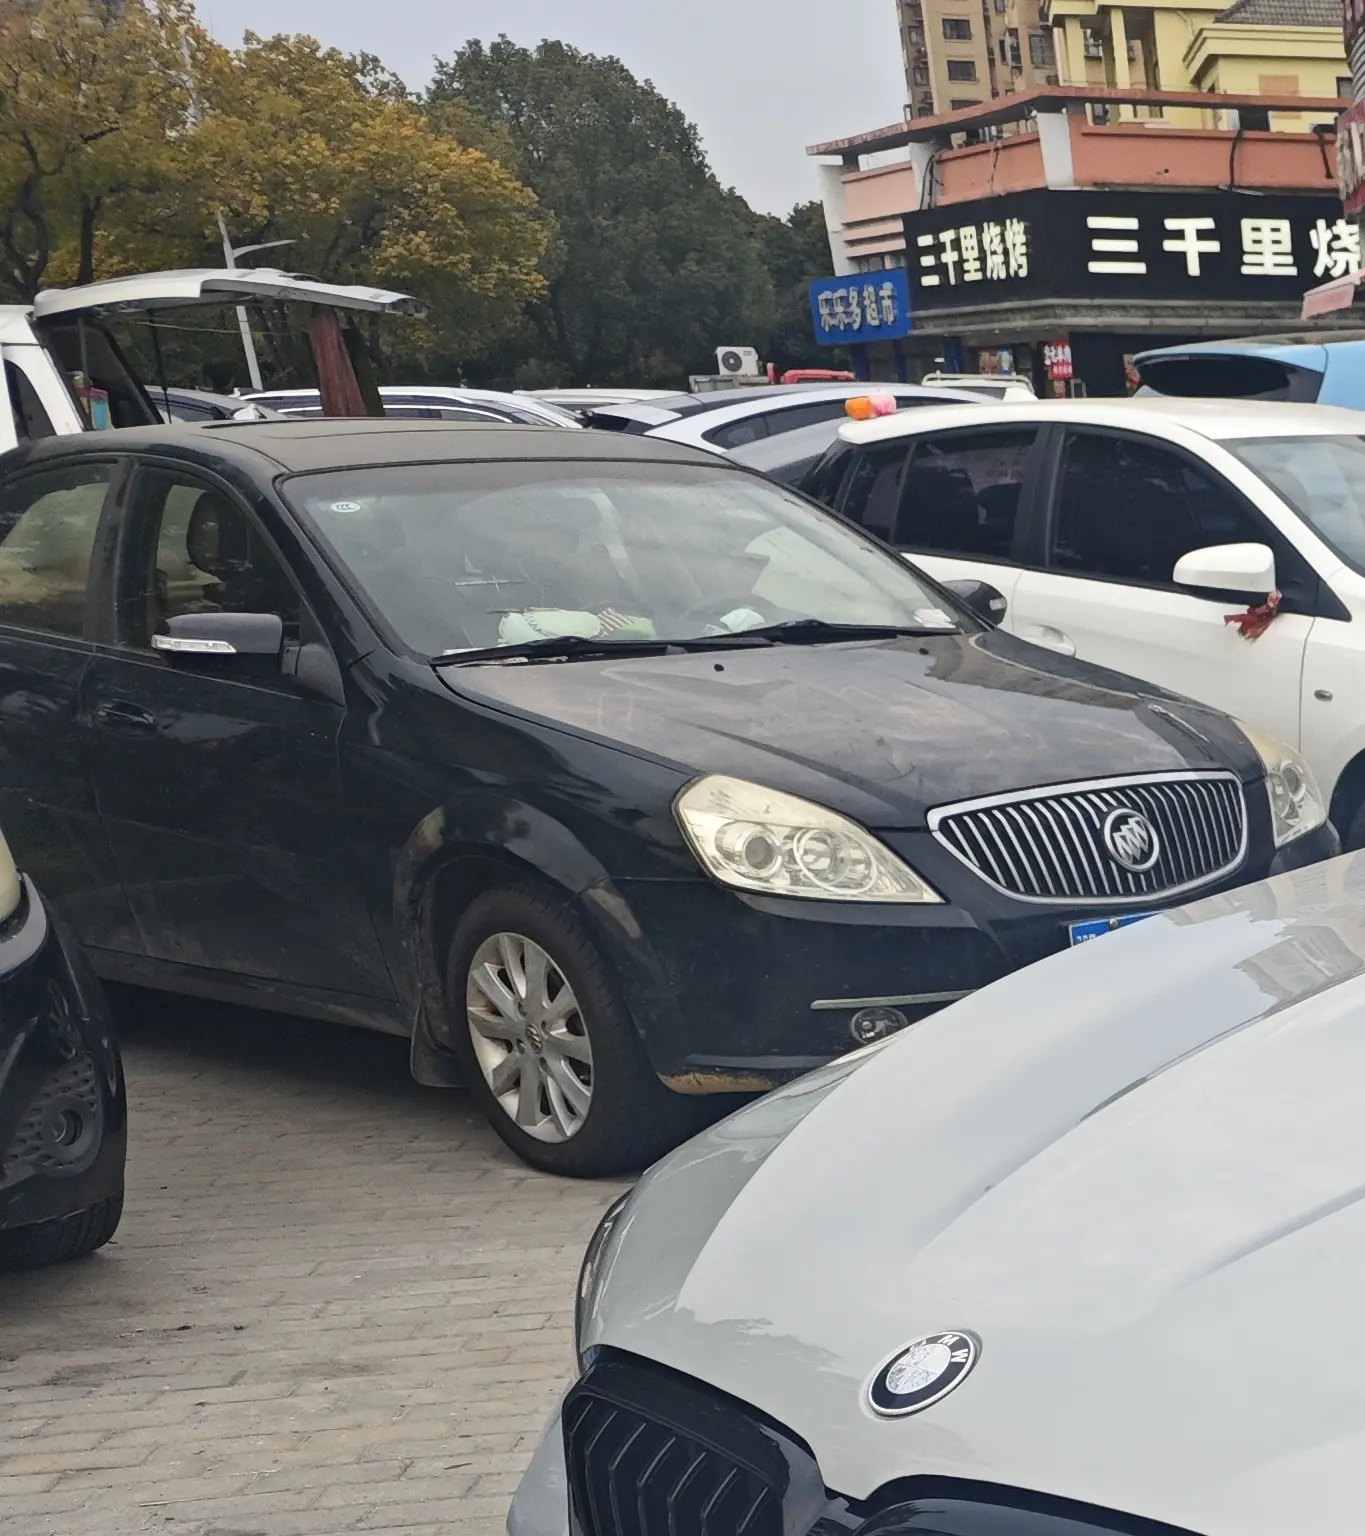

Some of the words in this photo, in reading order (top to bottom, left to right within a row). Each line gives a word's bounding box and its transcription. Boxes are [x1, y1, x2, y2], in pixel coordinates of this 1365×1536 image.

[917, 217, 1029, 287] 三千里烧烤
[1086, 216, 1361, 279] 三千里烧
[818, 281, 897, 332] 乐乐多超市
